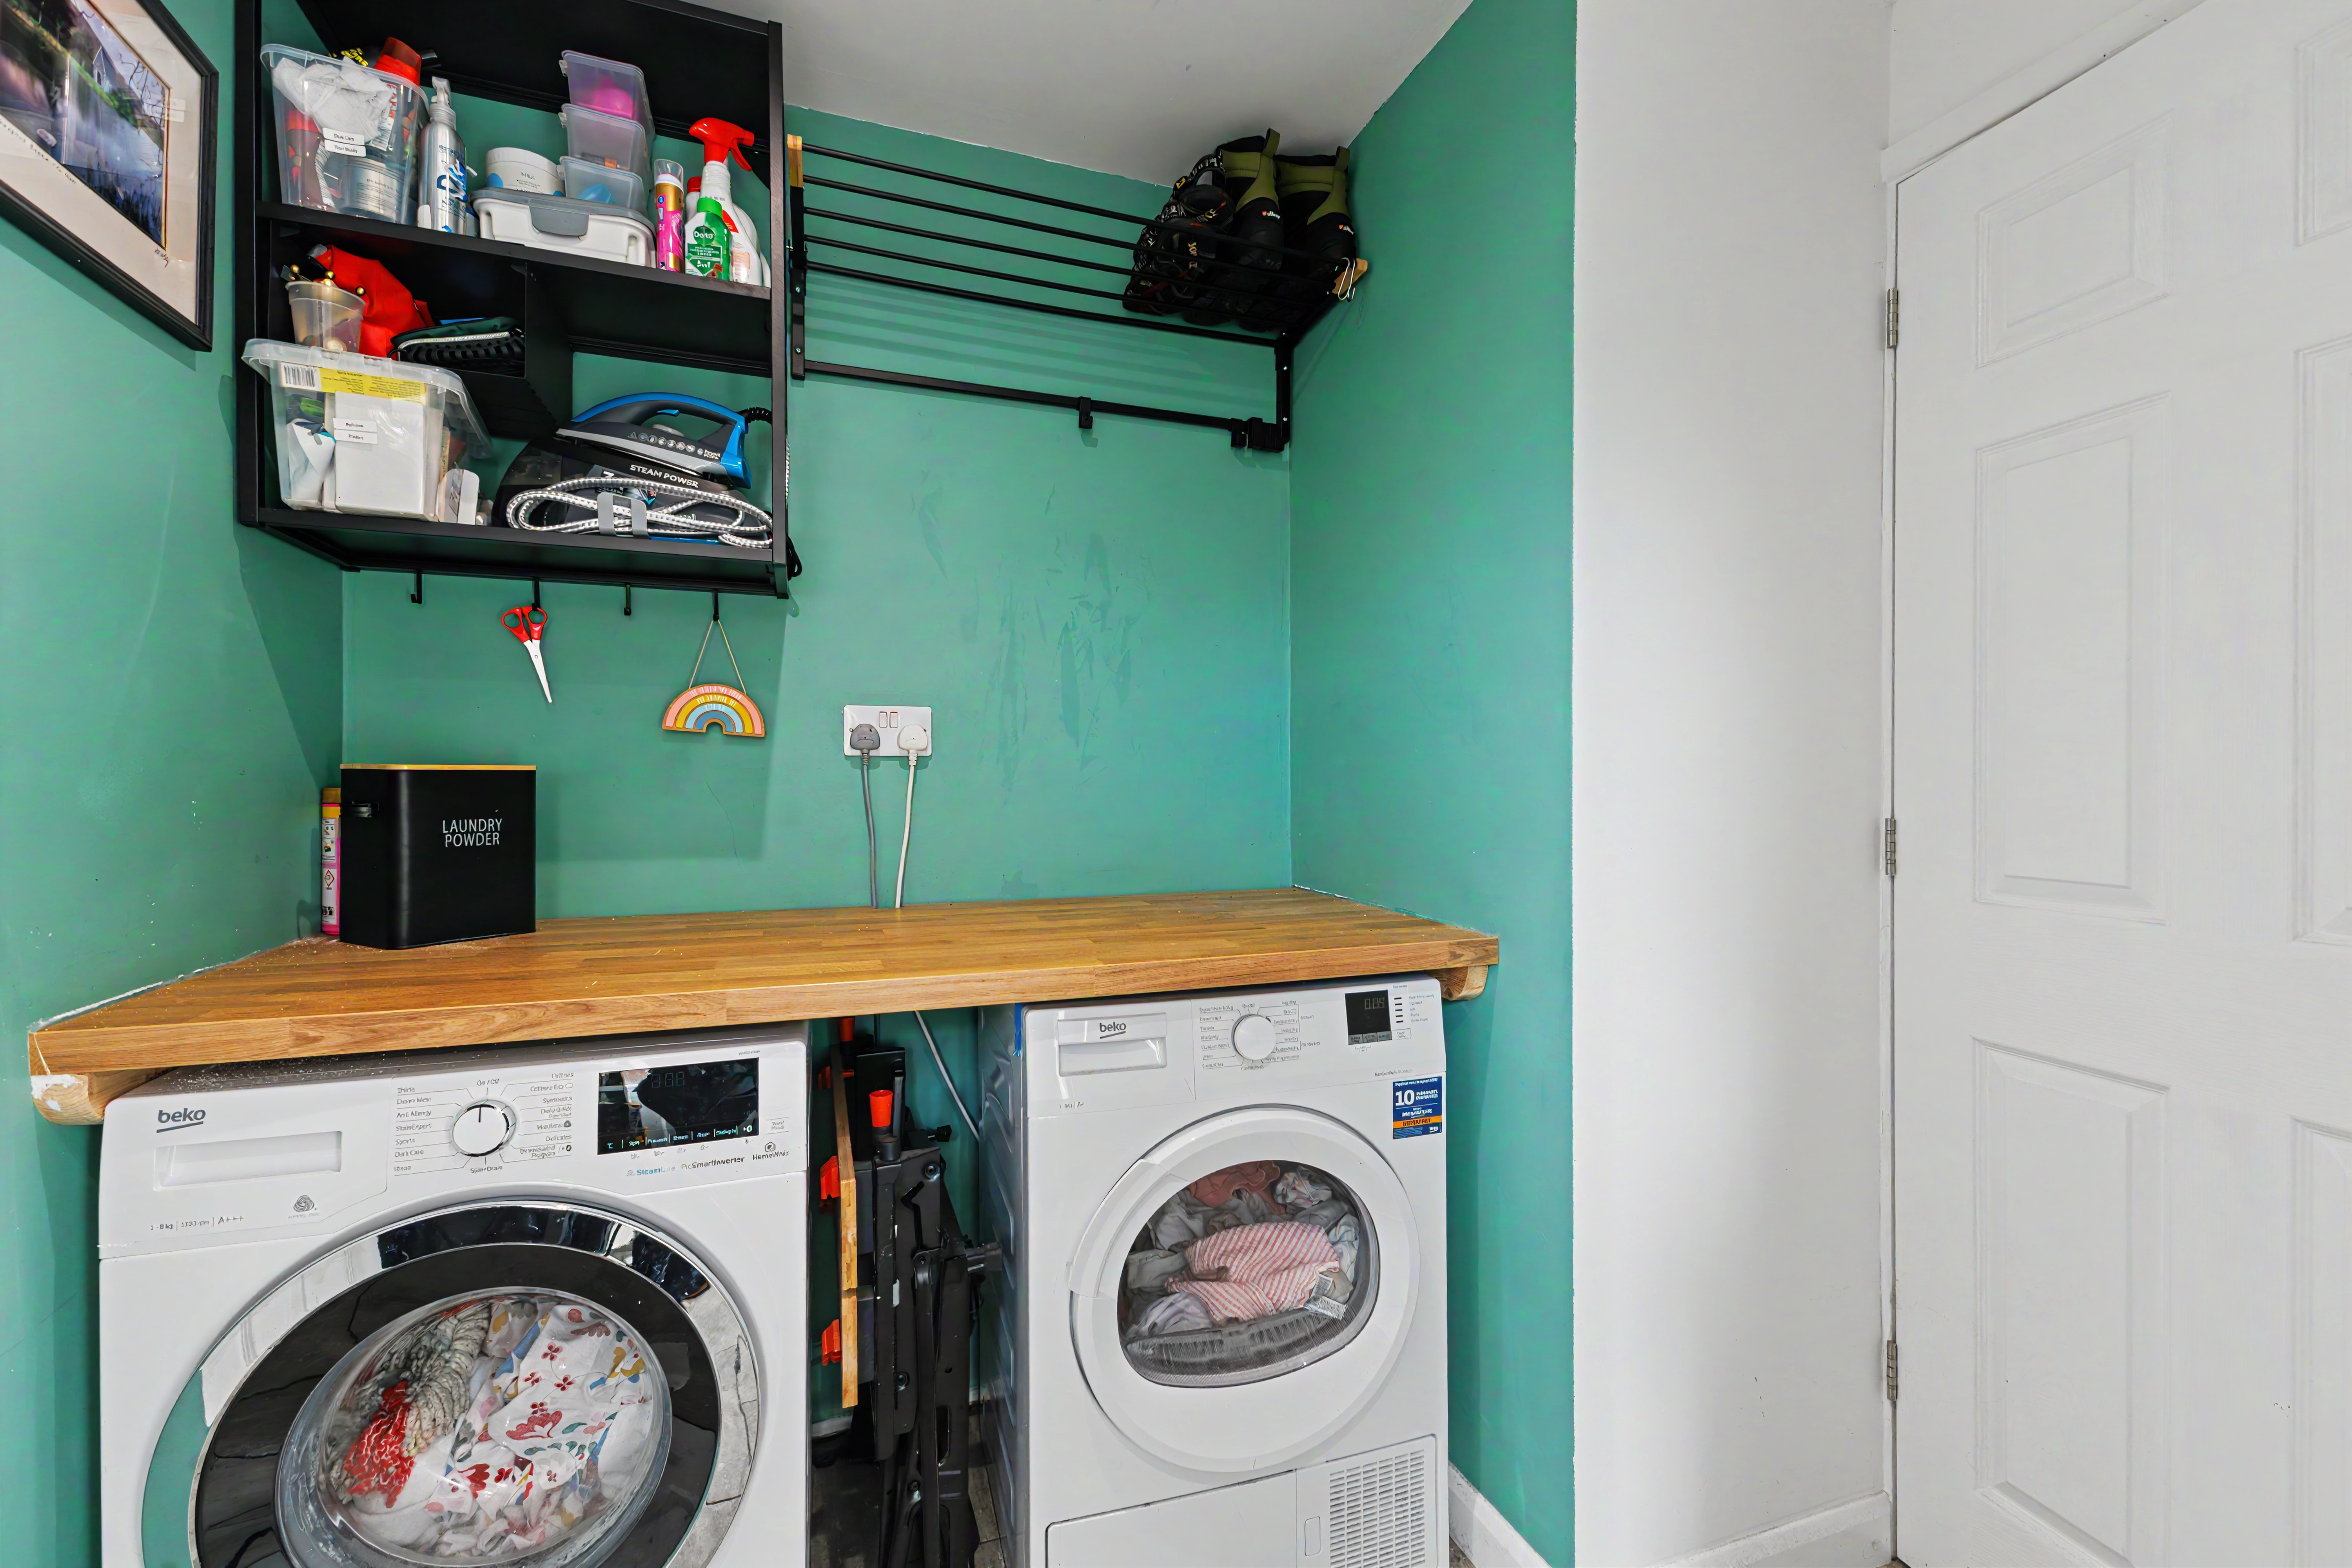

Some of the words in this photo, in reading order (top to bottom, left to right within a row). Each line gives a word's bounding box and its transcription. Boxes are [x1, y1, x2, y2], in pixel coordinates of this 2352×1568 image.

[630, 465, 662, 478] STEAM
[443, 818, 502, 833] LAUNDRY
[445, 832, 499, 848] POWDER
[1099, 1021, 1127, 1033] beko
[1396, 1089, 1415, 1106] 10
[158, 1107, 206, 1123] beko
